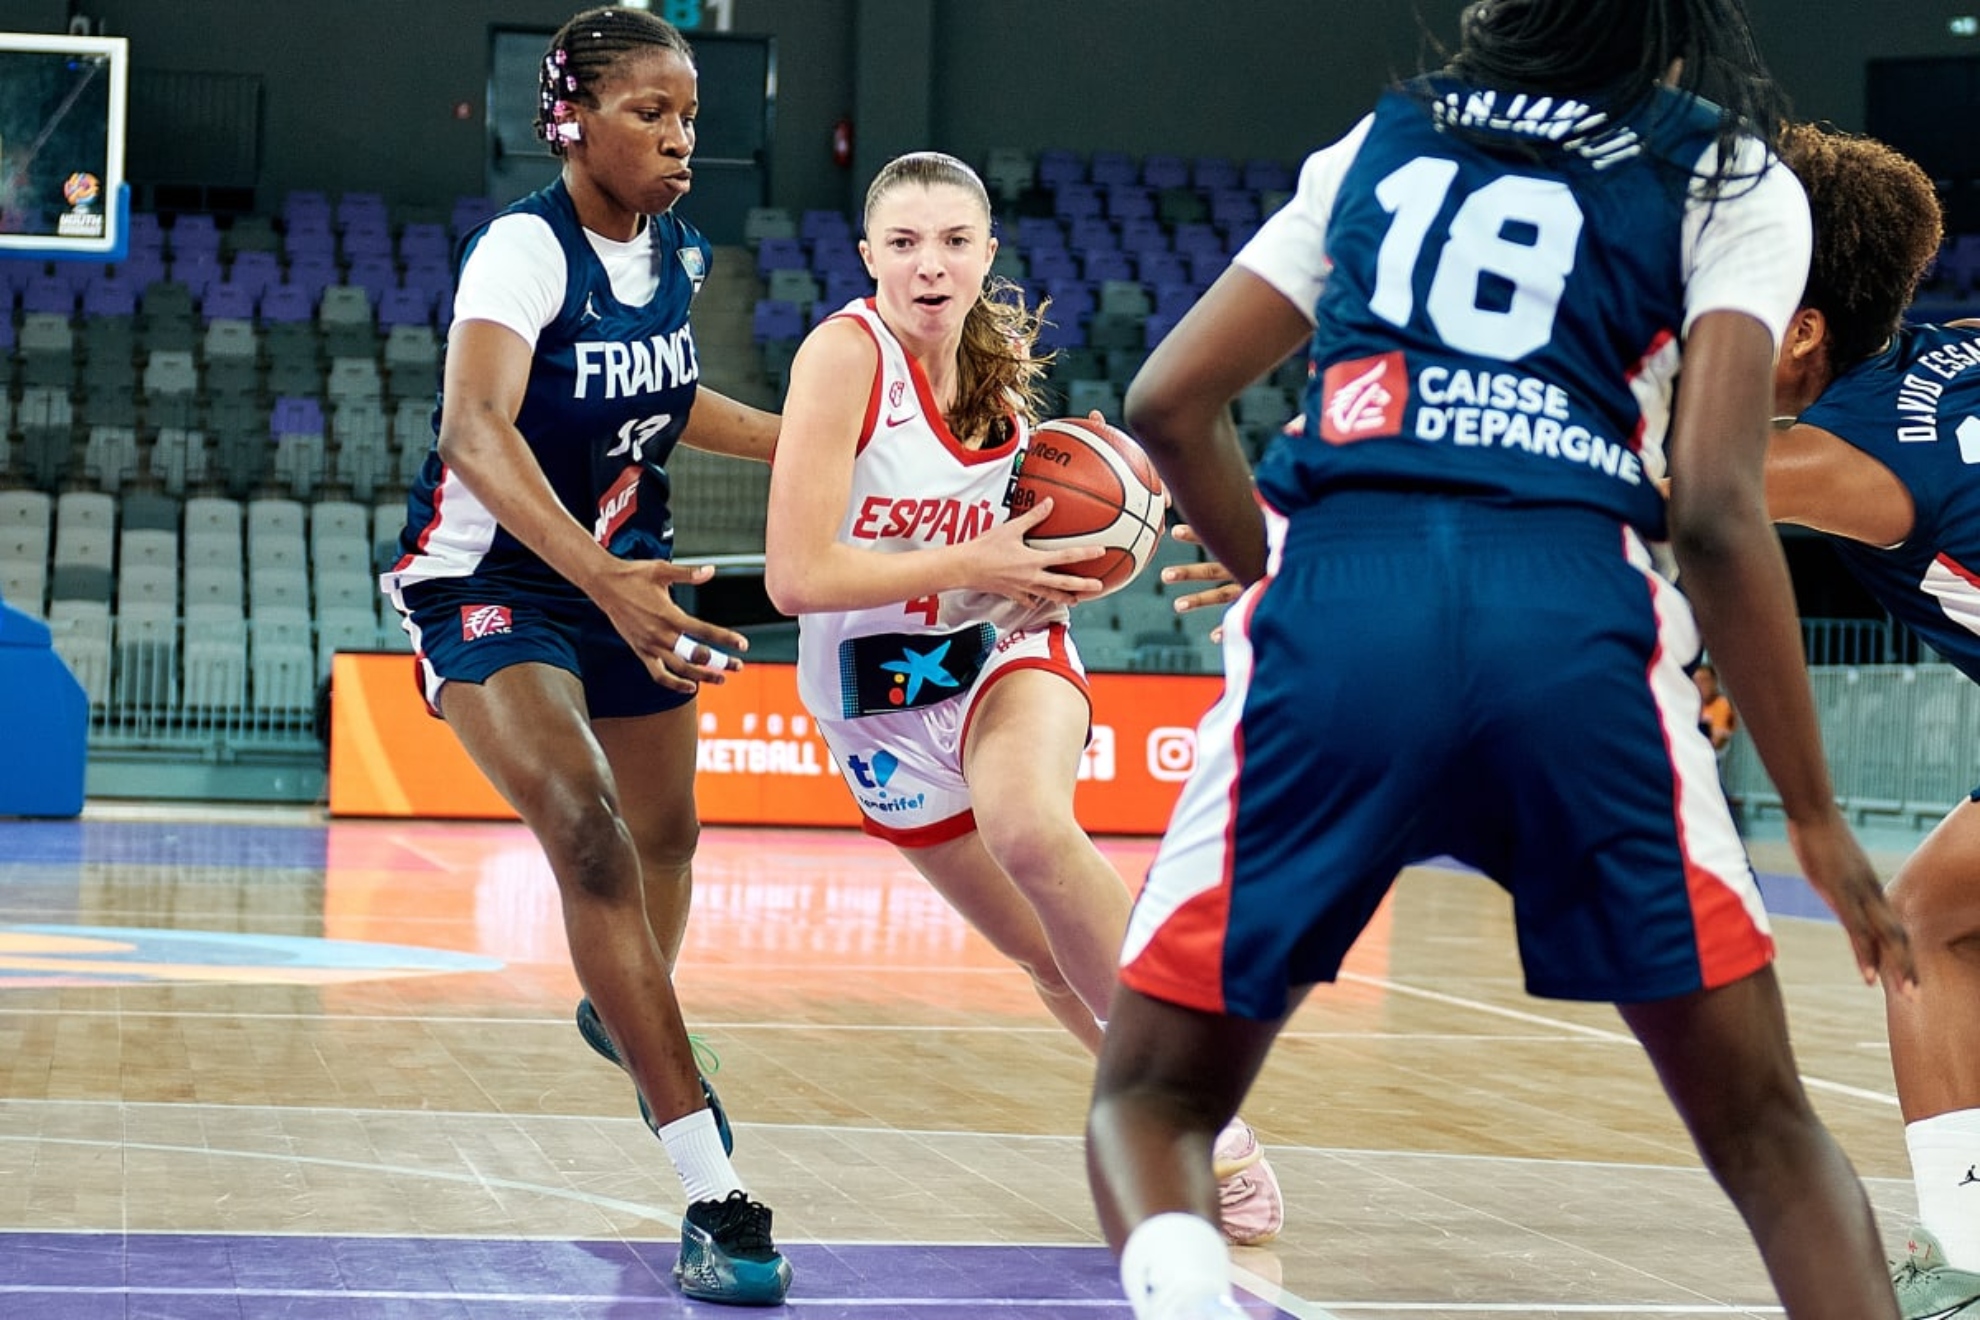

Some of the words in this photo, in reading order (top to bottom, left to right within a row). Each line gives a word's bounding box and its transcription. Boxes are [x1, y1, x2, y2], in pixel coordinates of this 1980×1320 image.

[1368, 156, 1584, 362] 18
[1418, 366, 1570, 421] CAISSE
[1897, 373, 1943, 442] DAVID
[1415, 406, 1642, 486] D'EPARGNE
